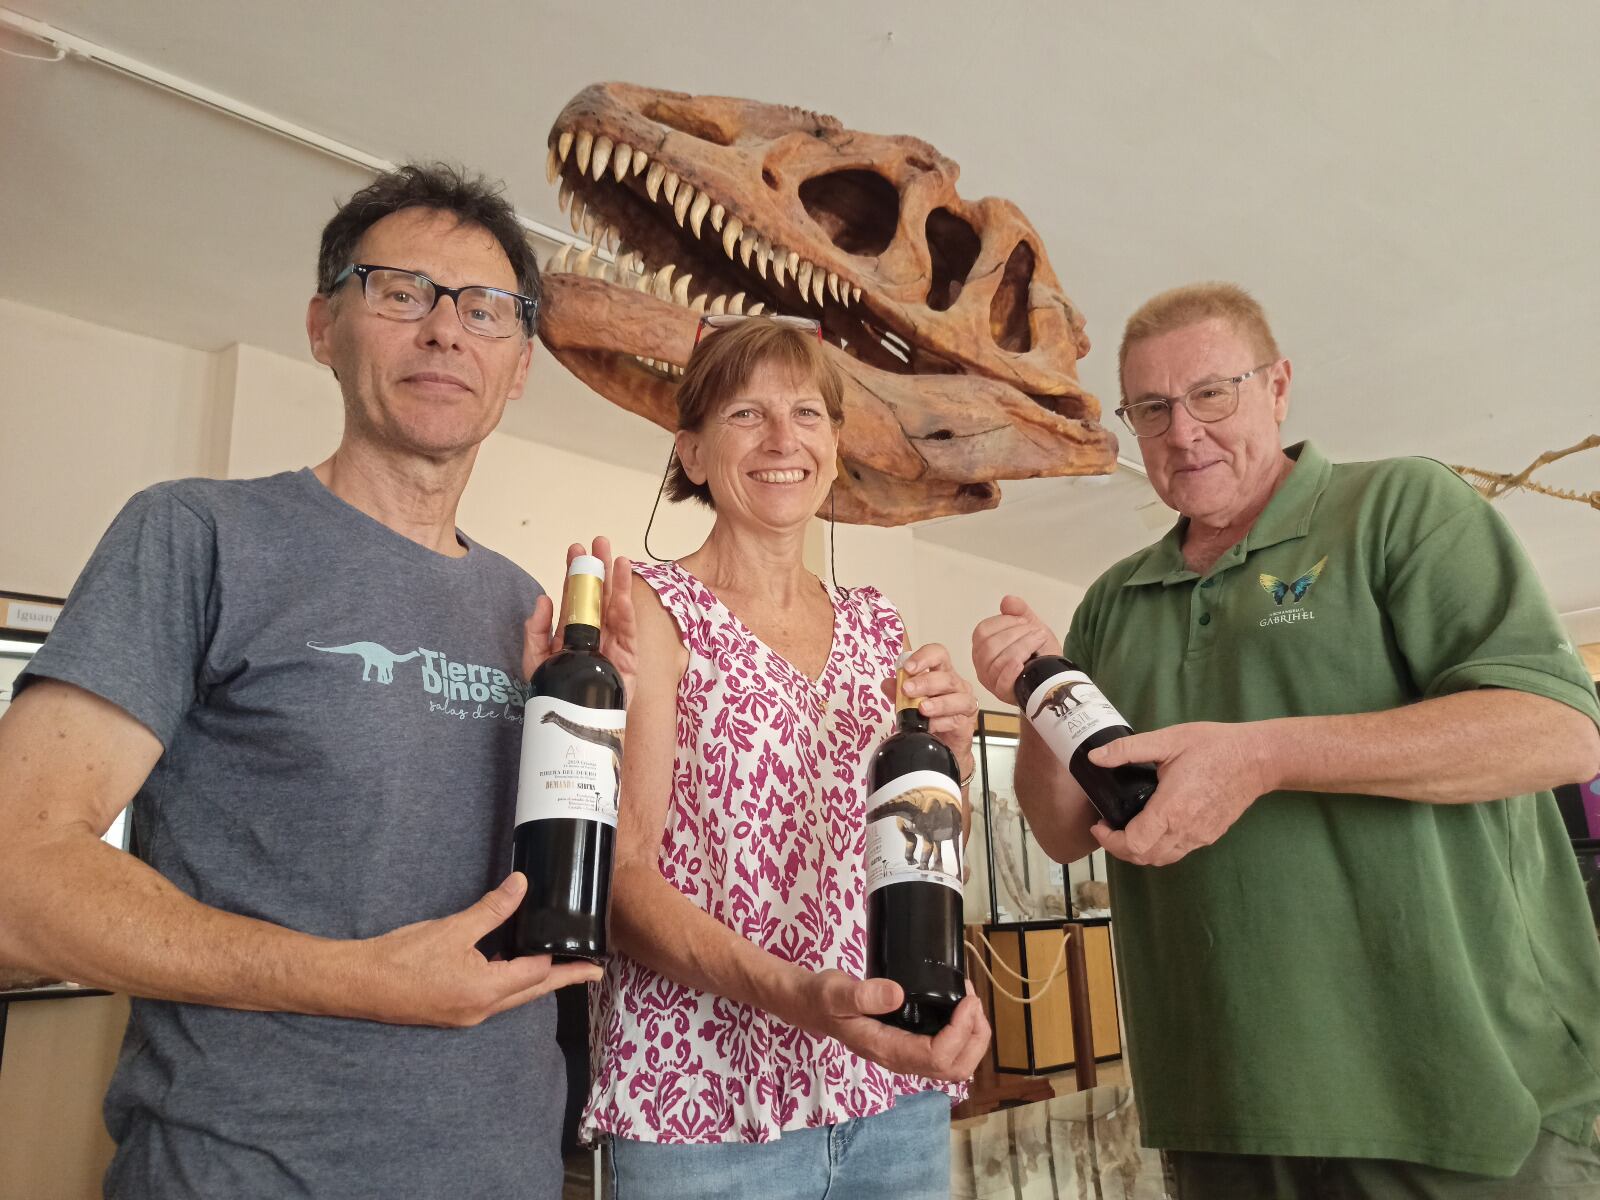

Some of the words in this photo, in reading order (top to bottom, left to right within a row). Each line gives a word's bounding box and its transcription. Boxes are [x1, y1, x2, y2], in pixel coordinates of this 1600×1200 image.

[1259, 611, 1315, 627] GABRIHEL
[418, 647, 512, 688] Tierra
[429, 699, 469, 720] salas
[472, 703, 500, 719] de
